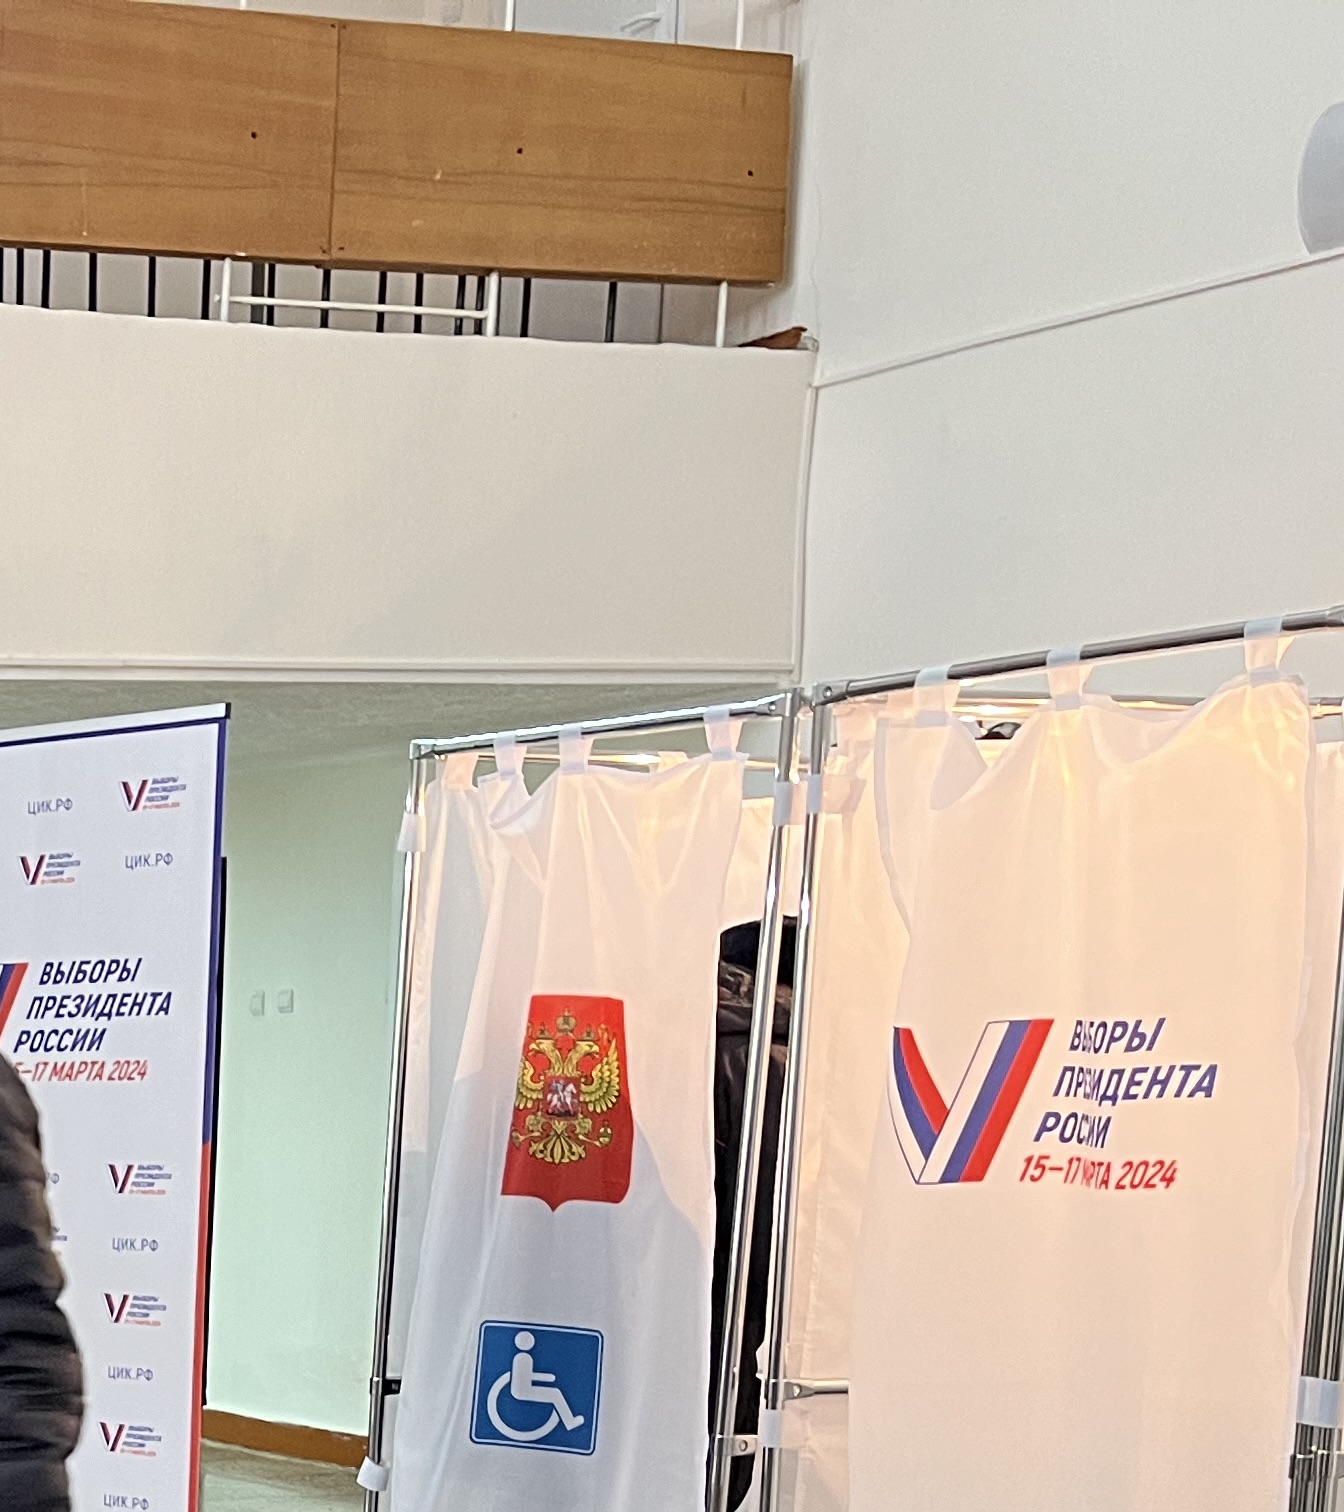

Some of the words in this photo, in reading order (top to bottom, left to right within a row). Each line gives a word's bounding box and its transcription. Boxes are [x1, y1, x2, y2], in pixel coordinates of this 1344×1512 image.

[27, 797, 74, 815] ЦИК.РФ
[125, 852, 174, 870] ЦИК.РФ
[39, 958, 143, 986] ВЫБОРЫ
[25, 991, 173, 1021] ПРЕЗИДЕНТА
[13, 1028, 108, 1054] РОССИИ
[48, 1061, 106, 1082] МАРТА
[107, 1060, 148, 1081] 2024
[1115, 1160, 1179, 1190] 2024
[111, 1238, 159, 1252] ЦИК.РФ
[107, 1366, 154, 1381] ЦИК.РФ
[103, 1493, 149, 1511] ЦИК.РФ
